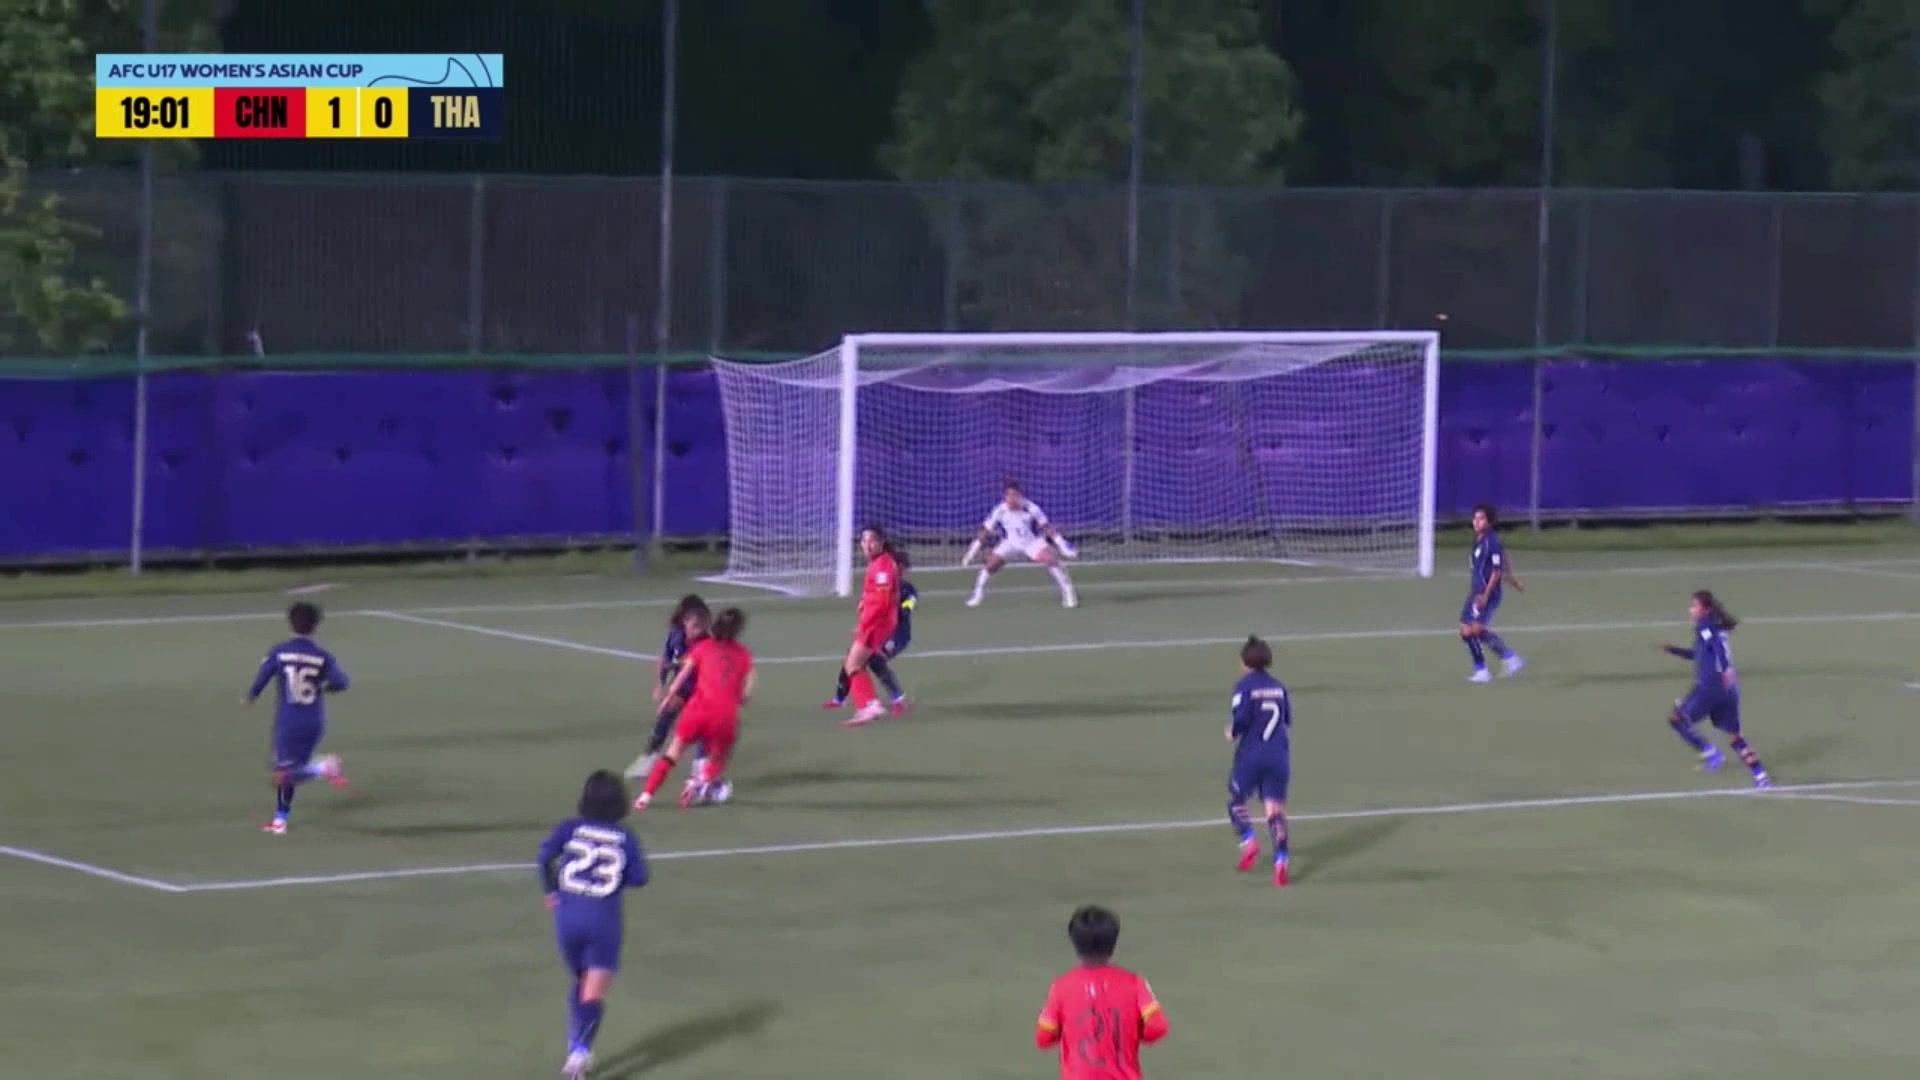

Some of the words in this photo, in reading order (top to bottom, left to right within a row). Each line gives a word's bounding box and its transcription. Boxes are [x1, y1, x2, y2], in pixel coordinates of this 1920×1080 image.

[283, 665, 320, 704] 16
[1261, 701, 1280, 741] 7
[560, 840, 627, 897] 23
[1076, 1006, 1121, 1067] 21
